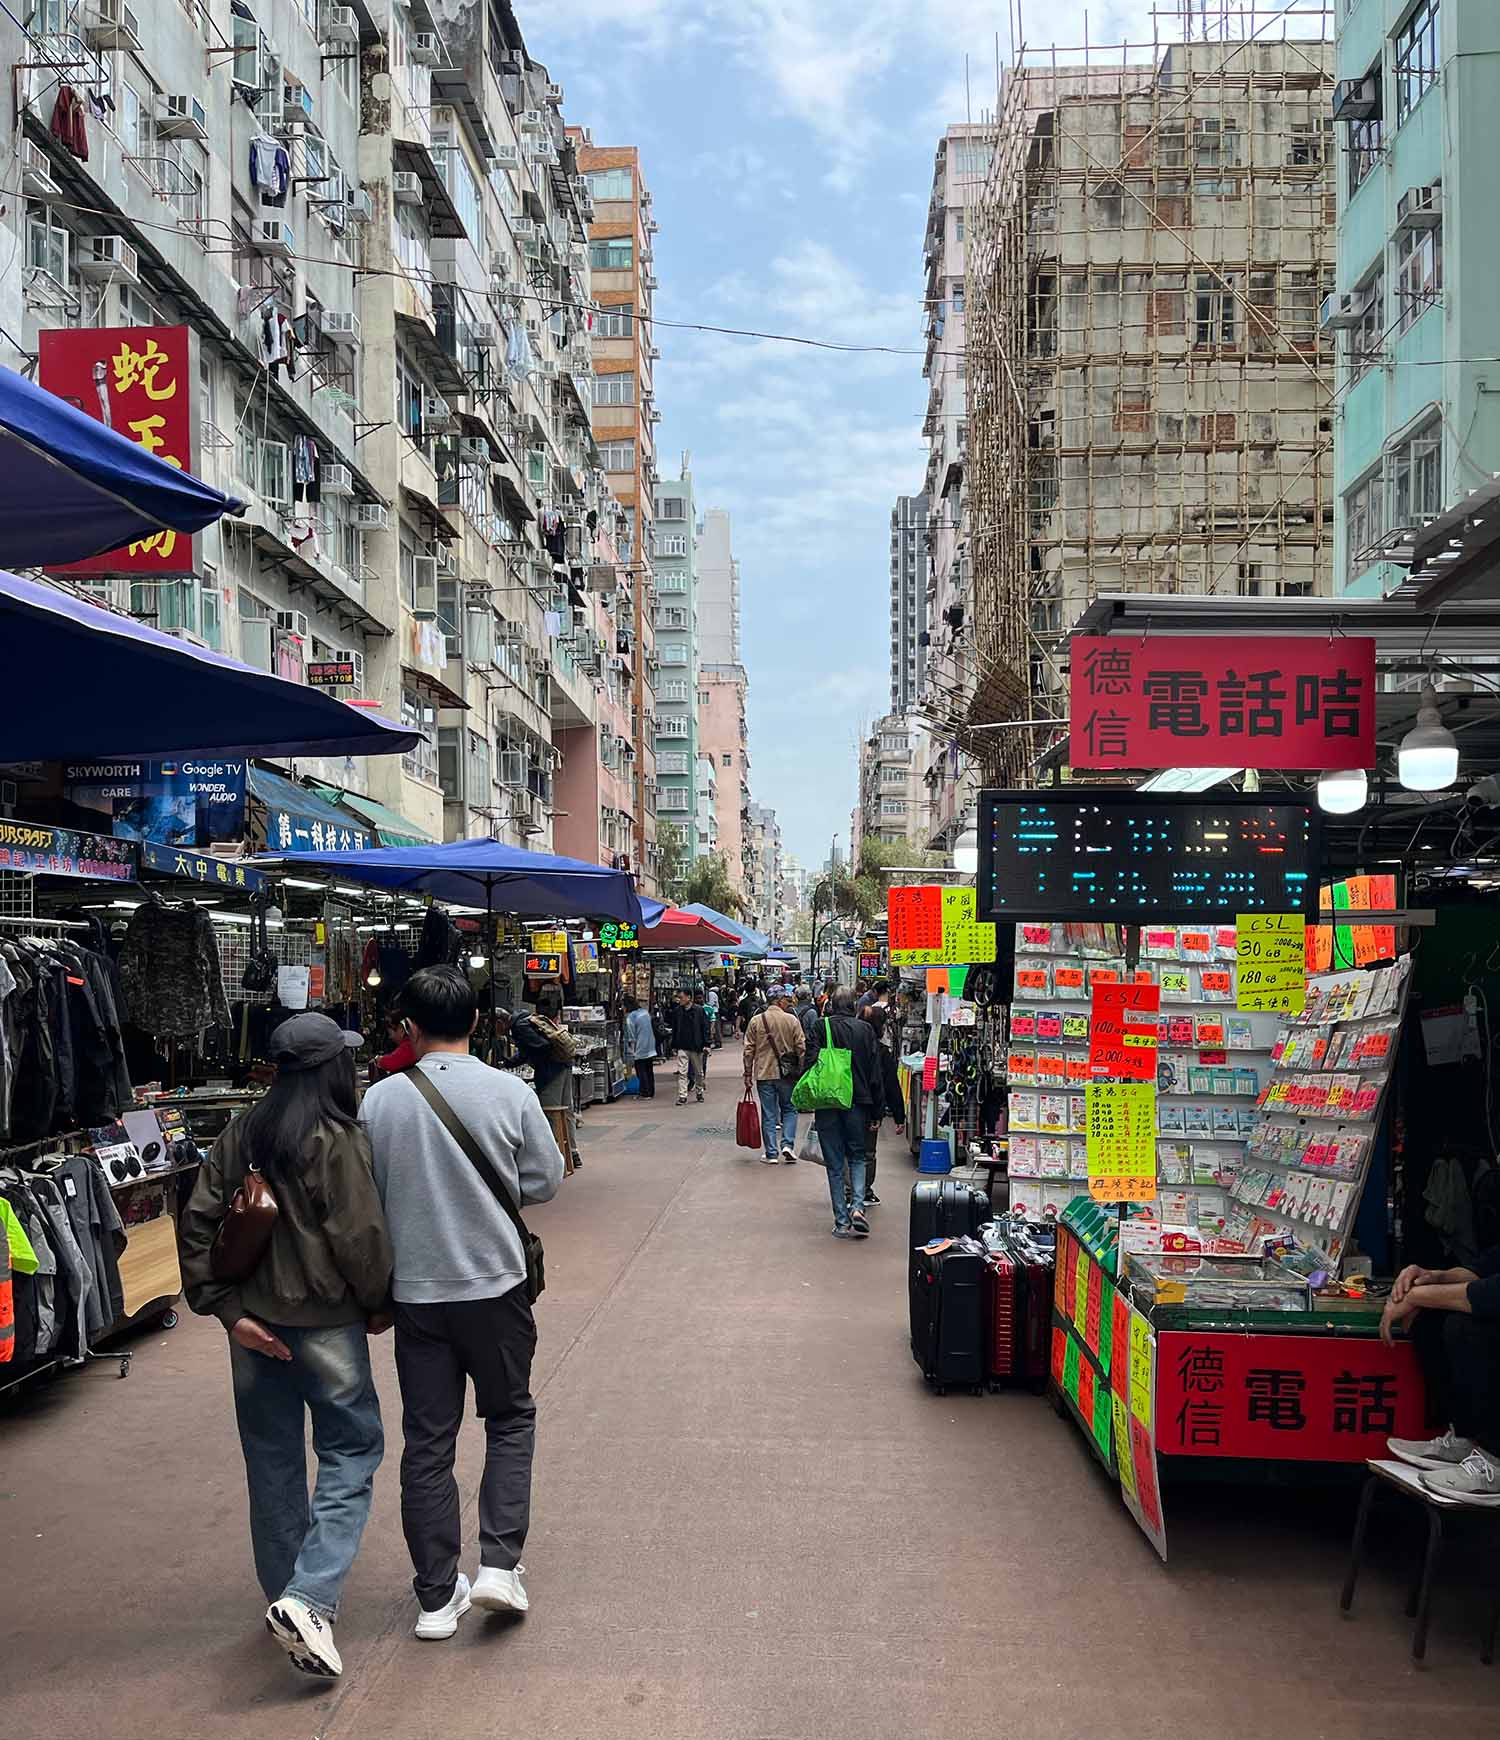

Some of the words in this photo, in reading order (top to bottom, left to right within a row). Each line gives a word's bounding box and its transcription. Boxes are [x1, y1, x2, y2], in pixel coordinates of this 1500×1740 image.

[1083, 648, 1132, 756] 德信
[1142, 669, 1362, 737] 電話咭
[67, 765, 140, 778] SKYWORTH
[182, 763, 223, 777] Google
[225, 764, 242, 775] TV
[102, 788, 132, 797] CARE
[189, 783, 226, 792] WONDER
[209, 793, 237, 801] AUDIO
[278, 813, 364, 851] 第一科技公司
[175, 853, 246, 887] 大中電業
[1251, 916, 1290, 930] CSL
[1237, 939, 1260, 956] 30
[1240, 970, 1261, 983] 180
[1176, 1346, 1225, 1446] 德信
